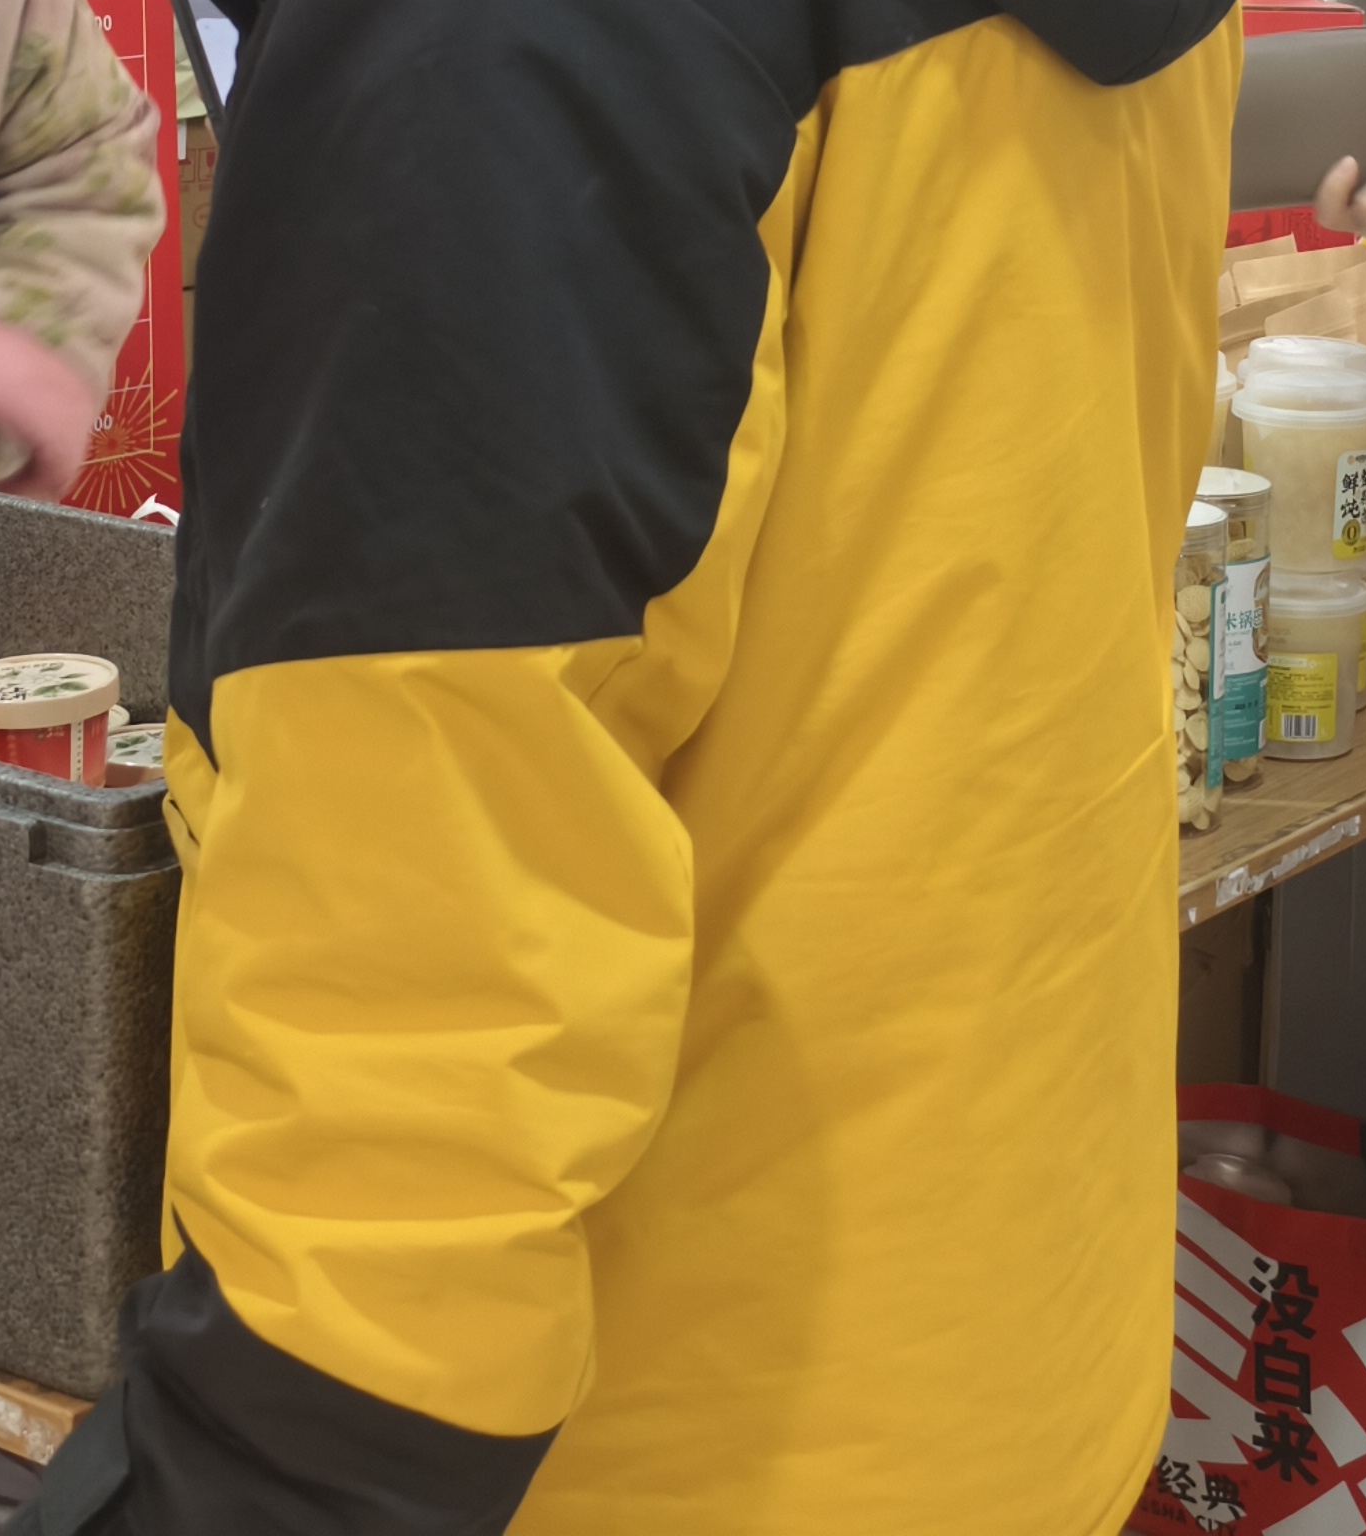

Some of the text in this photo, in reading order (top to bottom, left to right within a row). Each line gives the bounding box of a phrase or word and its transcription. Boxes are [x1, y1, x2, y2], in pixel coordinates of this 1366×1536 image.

[1340, 470, 1362, 520] 鲜炖
[1248, 1255, 1320, 1486] 没白来
[1154, 1454, 1248, 1522] 经典
